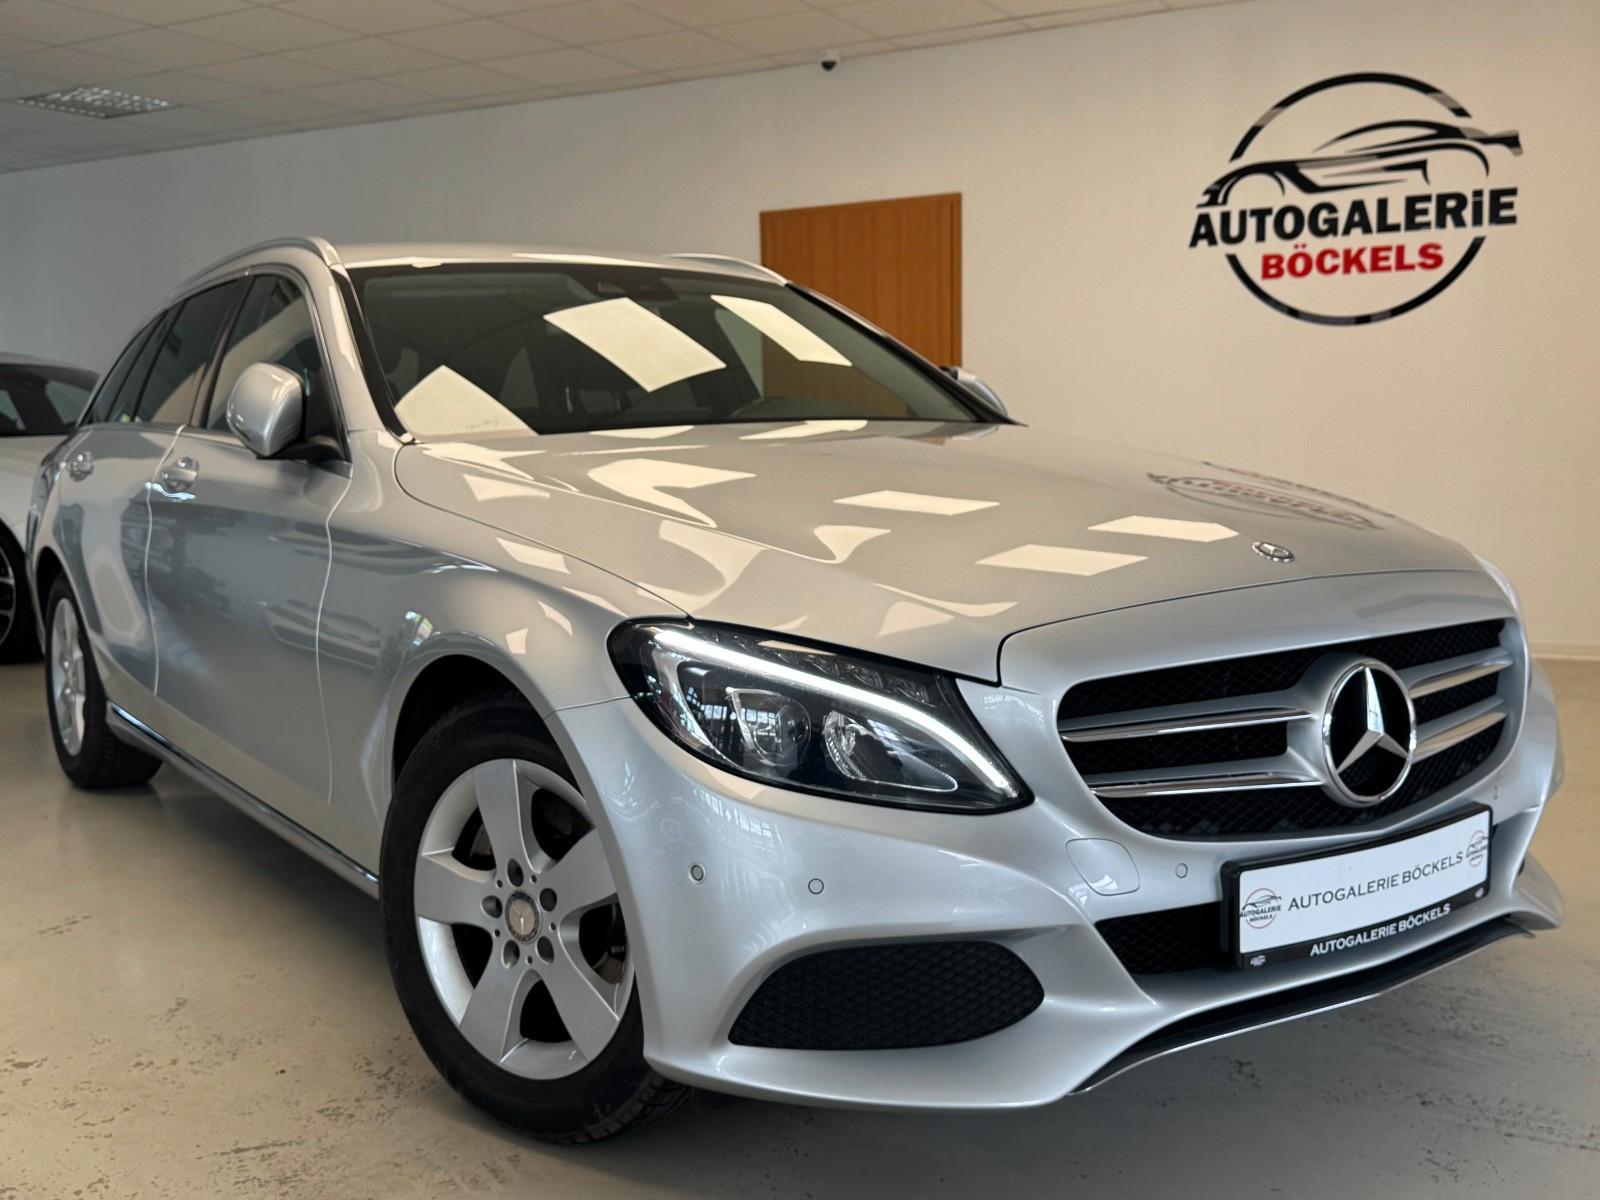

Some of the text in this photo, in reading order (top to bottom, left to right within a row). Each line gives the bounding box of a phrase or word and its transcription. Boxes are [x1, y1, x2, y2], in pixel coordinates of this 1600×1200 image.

[1261, 243, 1444, 281] BÖCKELS
[1287, 851, 1463, 912] AUTOGALERIE BÖCKELS
[1310, 903, 1451, 956] AUTOGALERIE BÖCKELS
